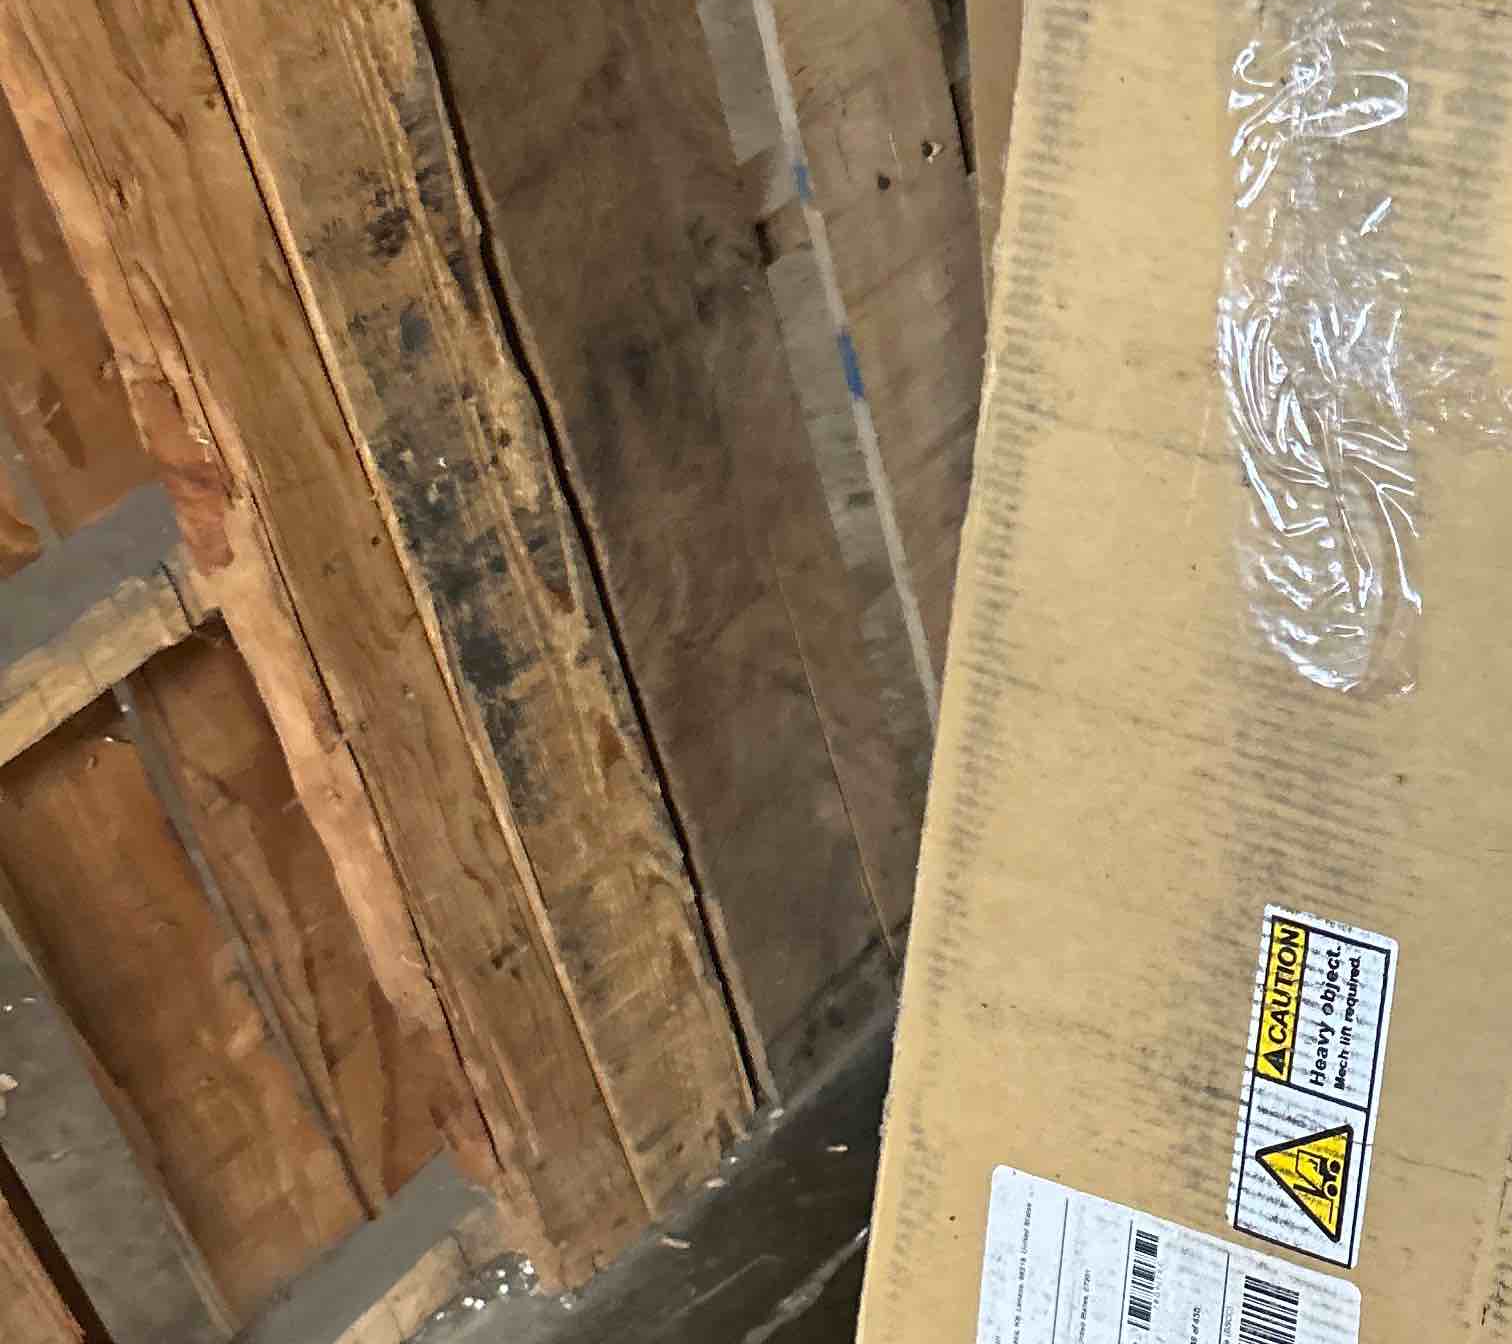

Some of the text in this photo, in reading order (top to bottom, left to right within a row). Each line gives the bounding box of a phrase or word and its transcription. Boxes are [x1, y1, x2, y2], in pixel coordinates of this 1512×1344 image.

[1268, 925, 1300, 1045] CAUTION
[1309, 945, 1343, 1087] Heavy object.
